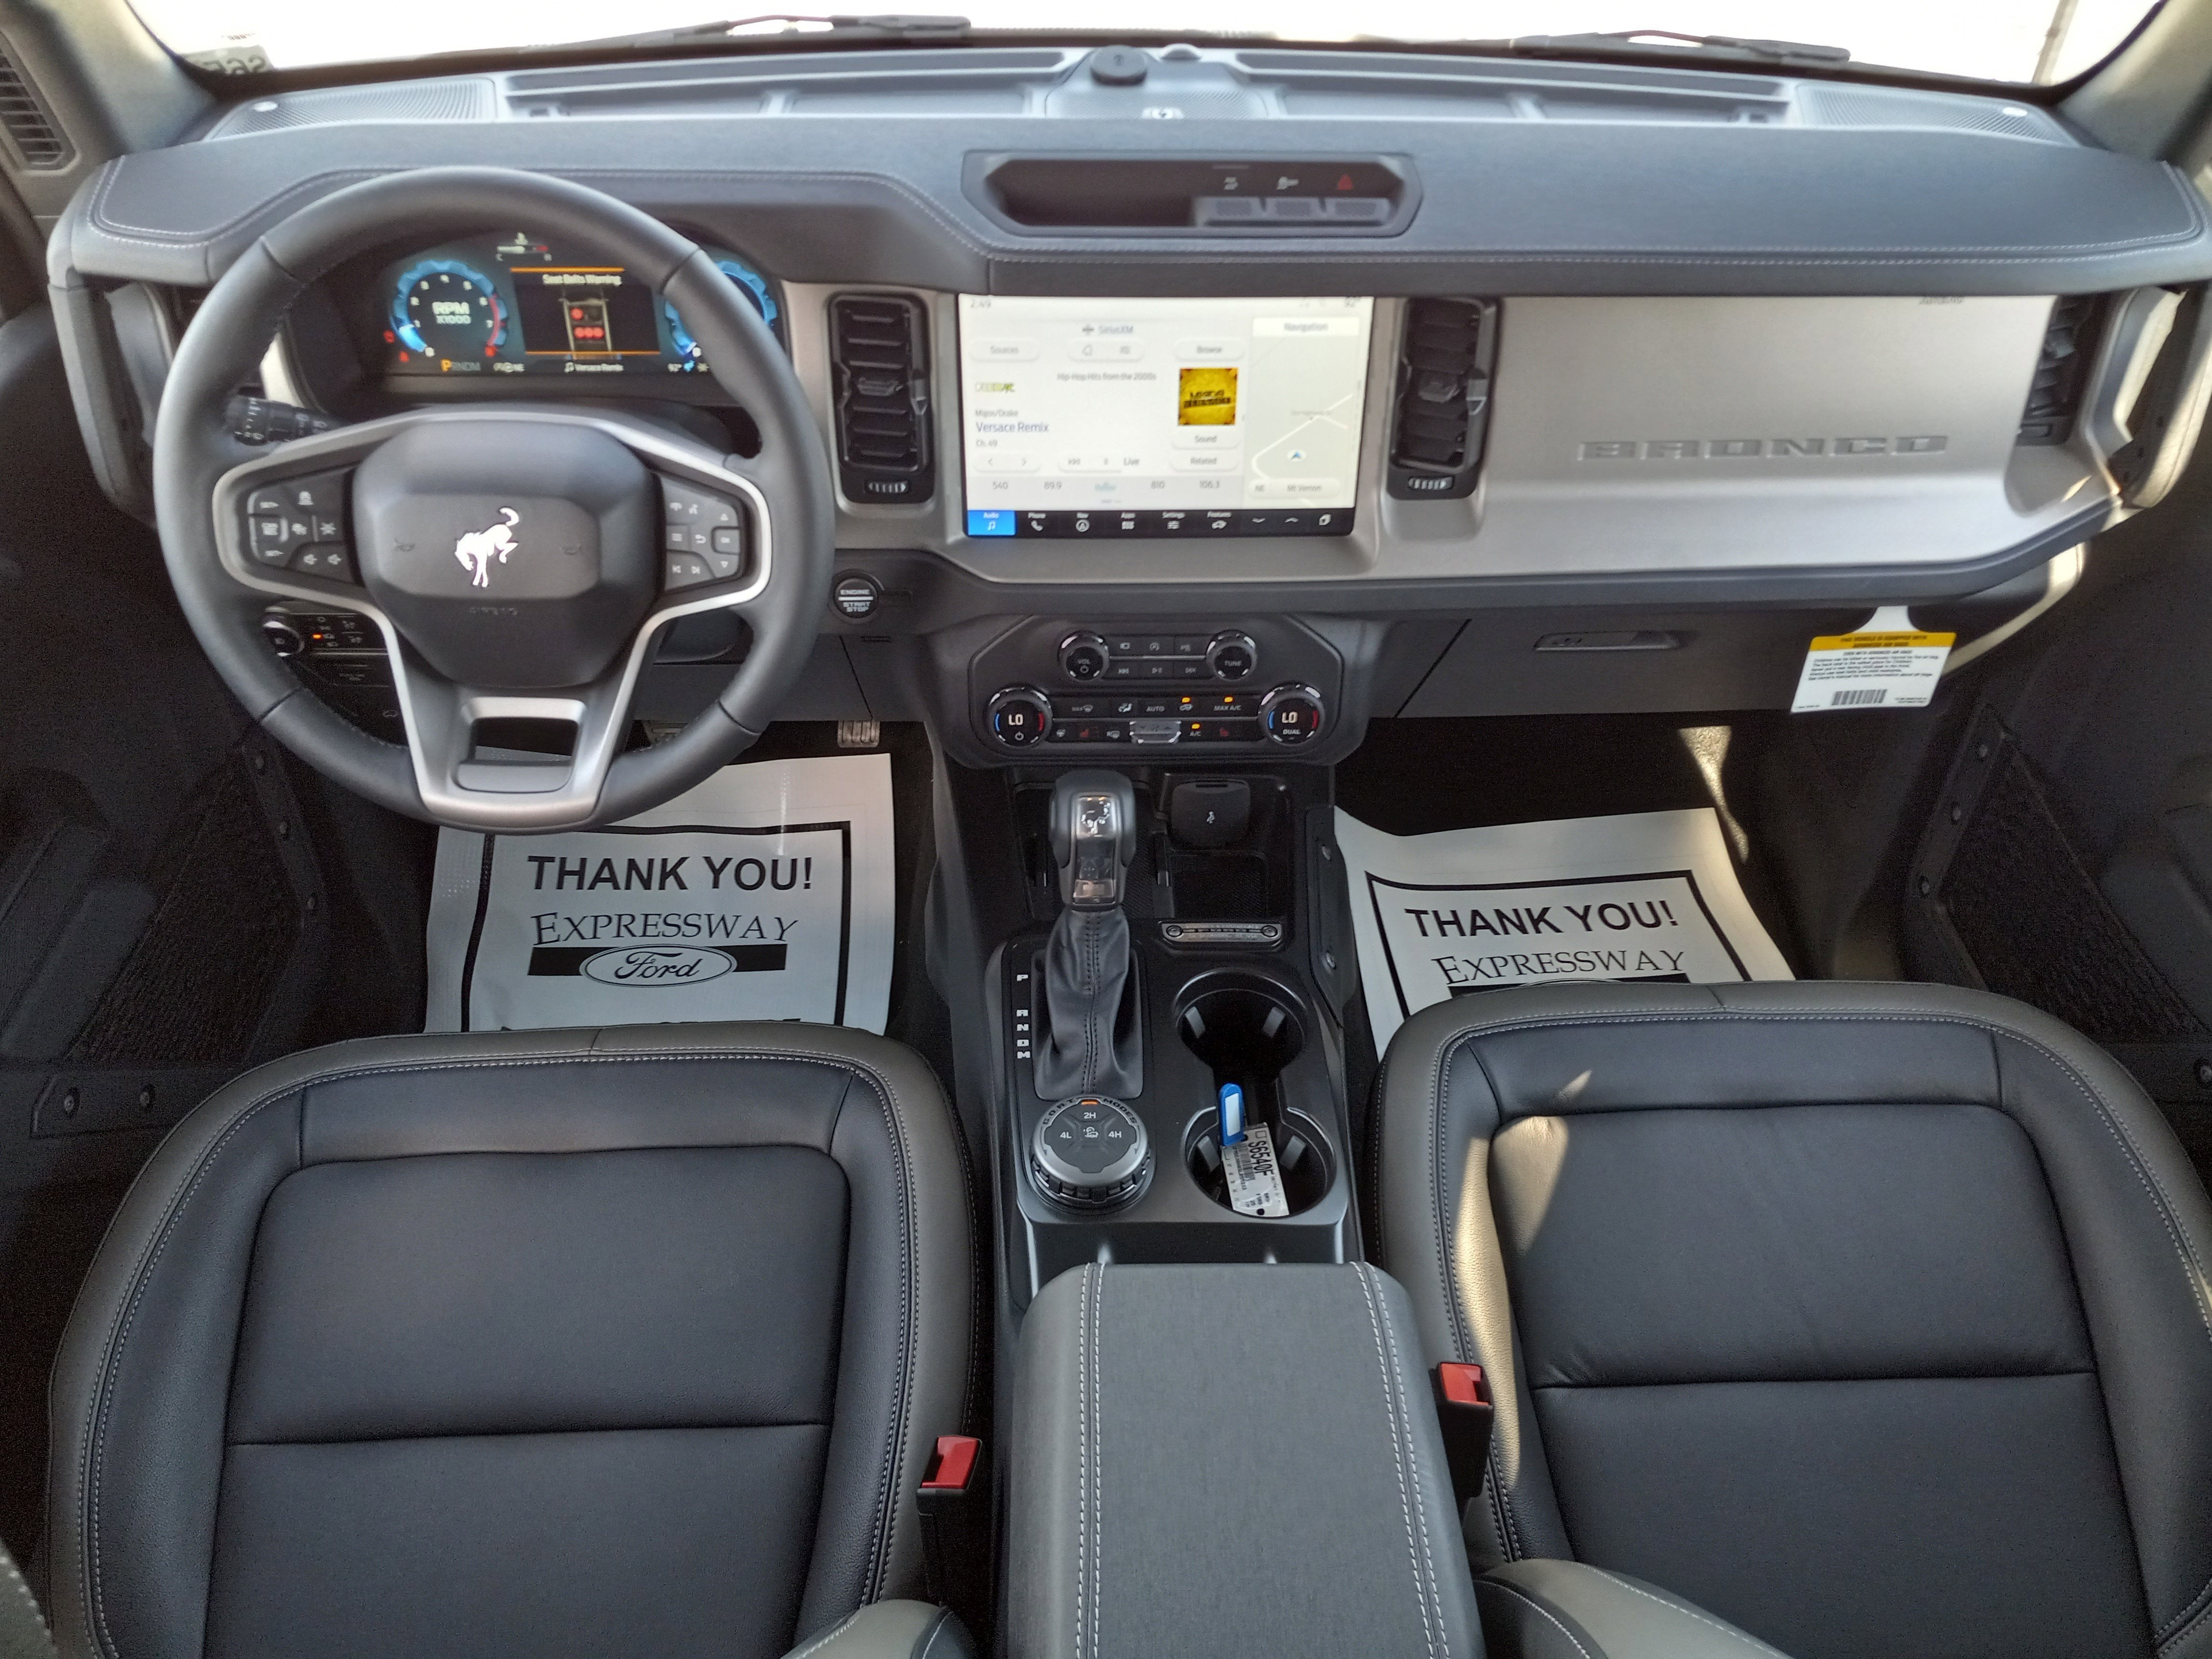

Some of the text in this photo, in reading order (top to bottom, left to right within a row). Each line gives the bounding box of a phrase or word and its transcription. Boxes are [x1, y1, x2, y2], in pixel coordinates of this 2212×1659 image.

[432, 301, 470, 315] RPM
[1283, 321, 1329, 333] Navigation
[990, 344, 1020, 354] Sources
[976, 421, 1050, 433] Versace Remix
[1194, 435, 1217, 444] Sound
[1576, 435, 1949, 461] BRONCO
[1123, 457, 1141, 466] Live
[1190, 457, 1218, 466] Related
[992, 481, 1009, 490] 540
[1008, 713, 1024, 726] LO
[1281, 711, 1298, 724] LO
[526, 854, 812, 892] THANK YOU!
[1404, 899, 1680, 938] THANK YOU!
[530, 912, 799, 946] EXPRESSWAY
[613, 950, 701, 981] Ford
[1431, 949, 1685, 986] EXPRESSWAY
[1017, 1023, 1029, 1032] N
[1017, 1051, 1031, 1059] M
[1103, 1098, 1138, 1124] MODES
[1059, 1131, 1072, 1139] 4L
[1107, 1130, 1122, 1139] 4H
[1248, 1140, 1274, 1177] S6540F
